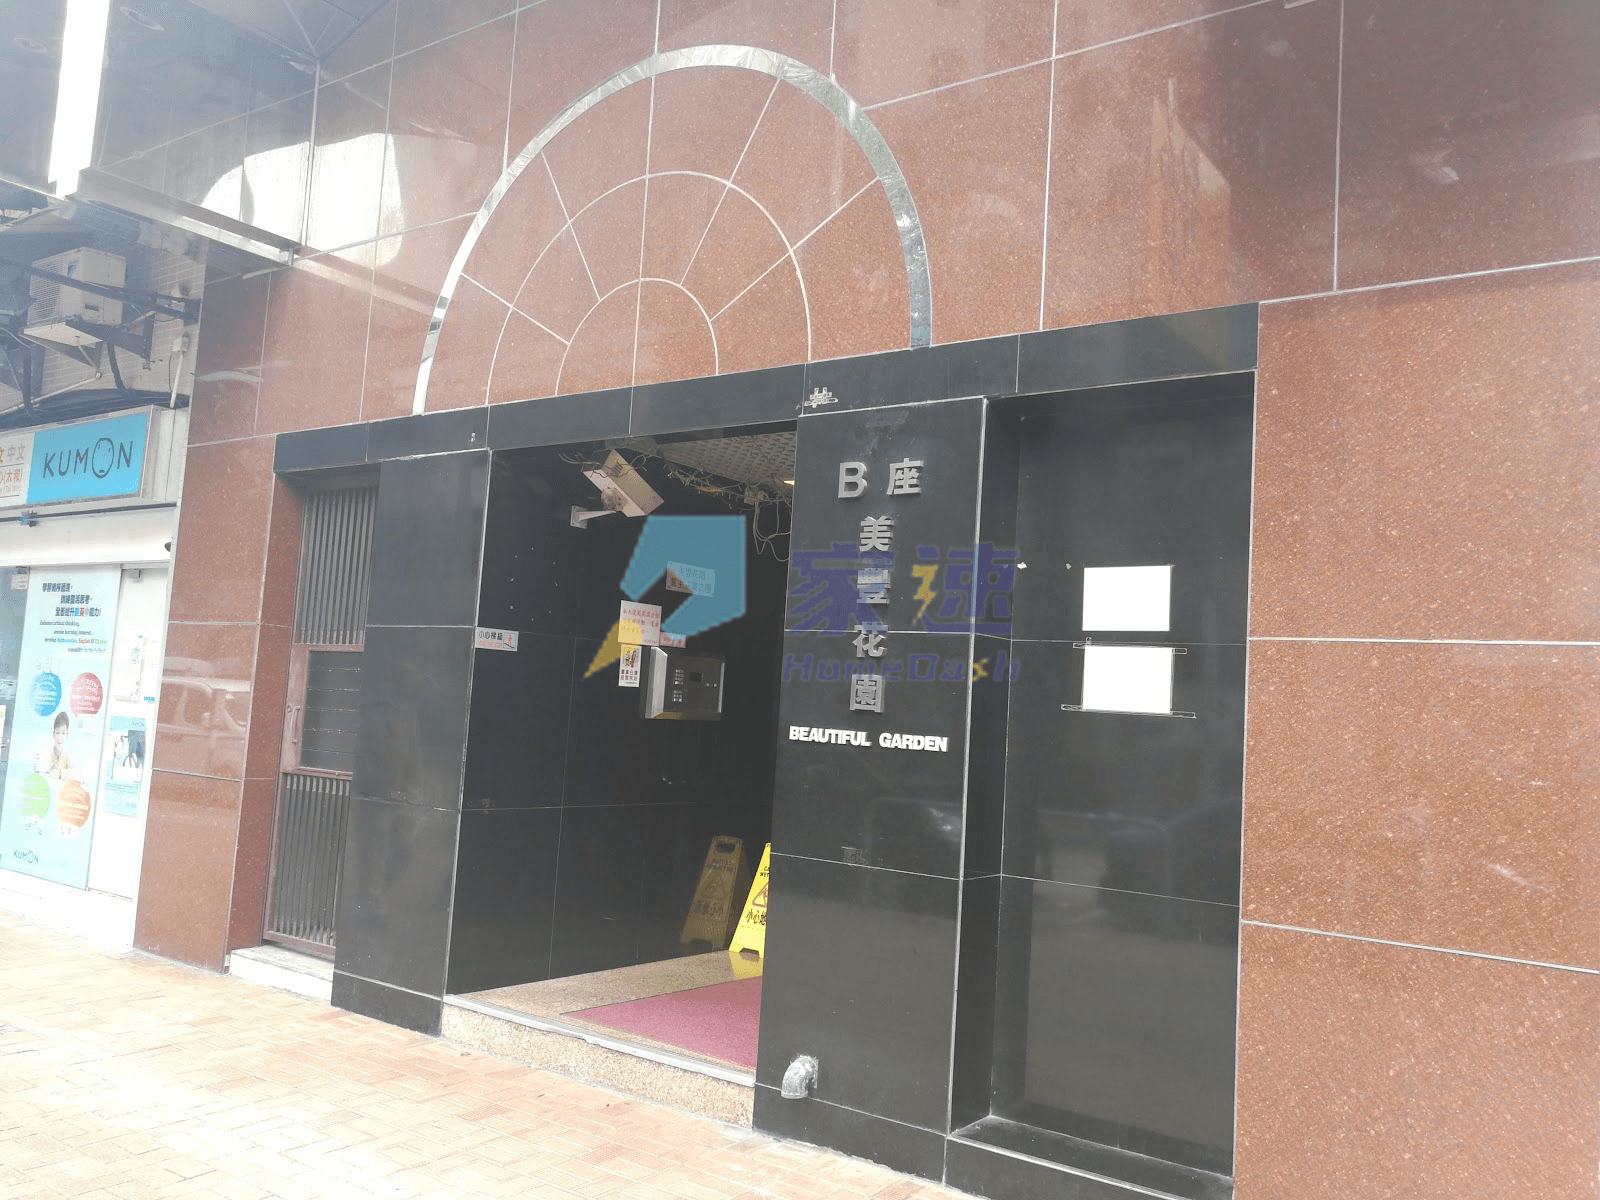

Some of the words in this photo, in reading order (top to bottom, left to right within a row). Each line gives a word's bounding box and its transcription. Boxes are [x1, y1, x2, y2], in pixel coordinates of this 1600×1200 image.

[42, 437, 133, 479] KUMON
[838, 461, 868, 499] B
[886, 458, 924, 495] 座
[789, 725, 871, 747] BEAUTIFUL
[879, 732, 948, 752] GARDEN
